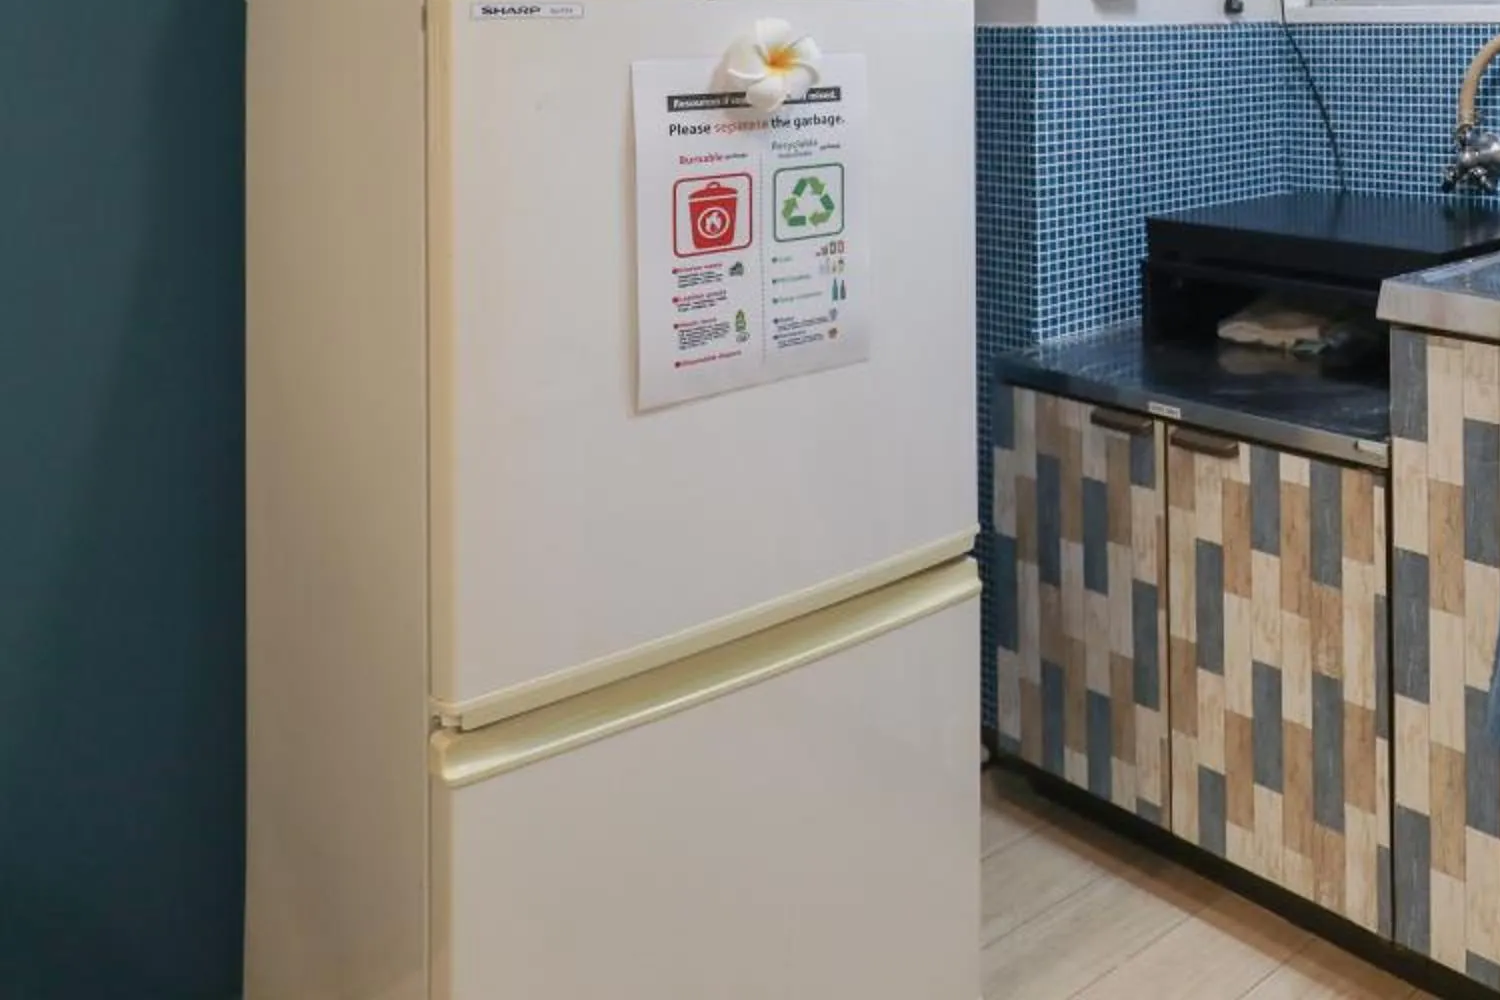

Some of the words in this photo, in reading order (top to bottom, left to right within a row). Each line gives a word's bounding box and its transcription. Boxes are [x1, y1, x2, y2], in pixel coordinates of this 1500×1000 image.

[481, 6, 541, 15] SHARP
[669, 122, 711, 136] Please
[771, 114, 791, 129] the
[793, 113, 846, 130] garbage.
